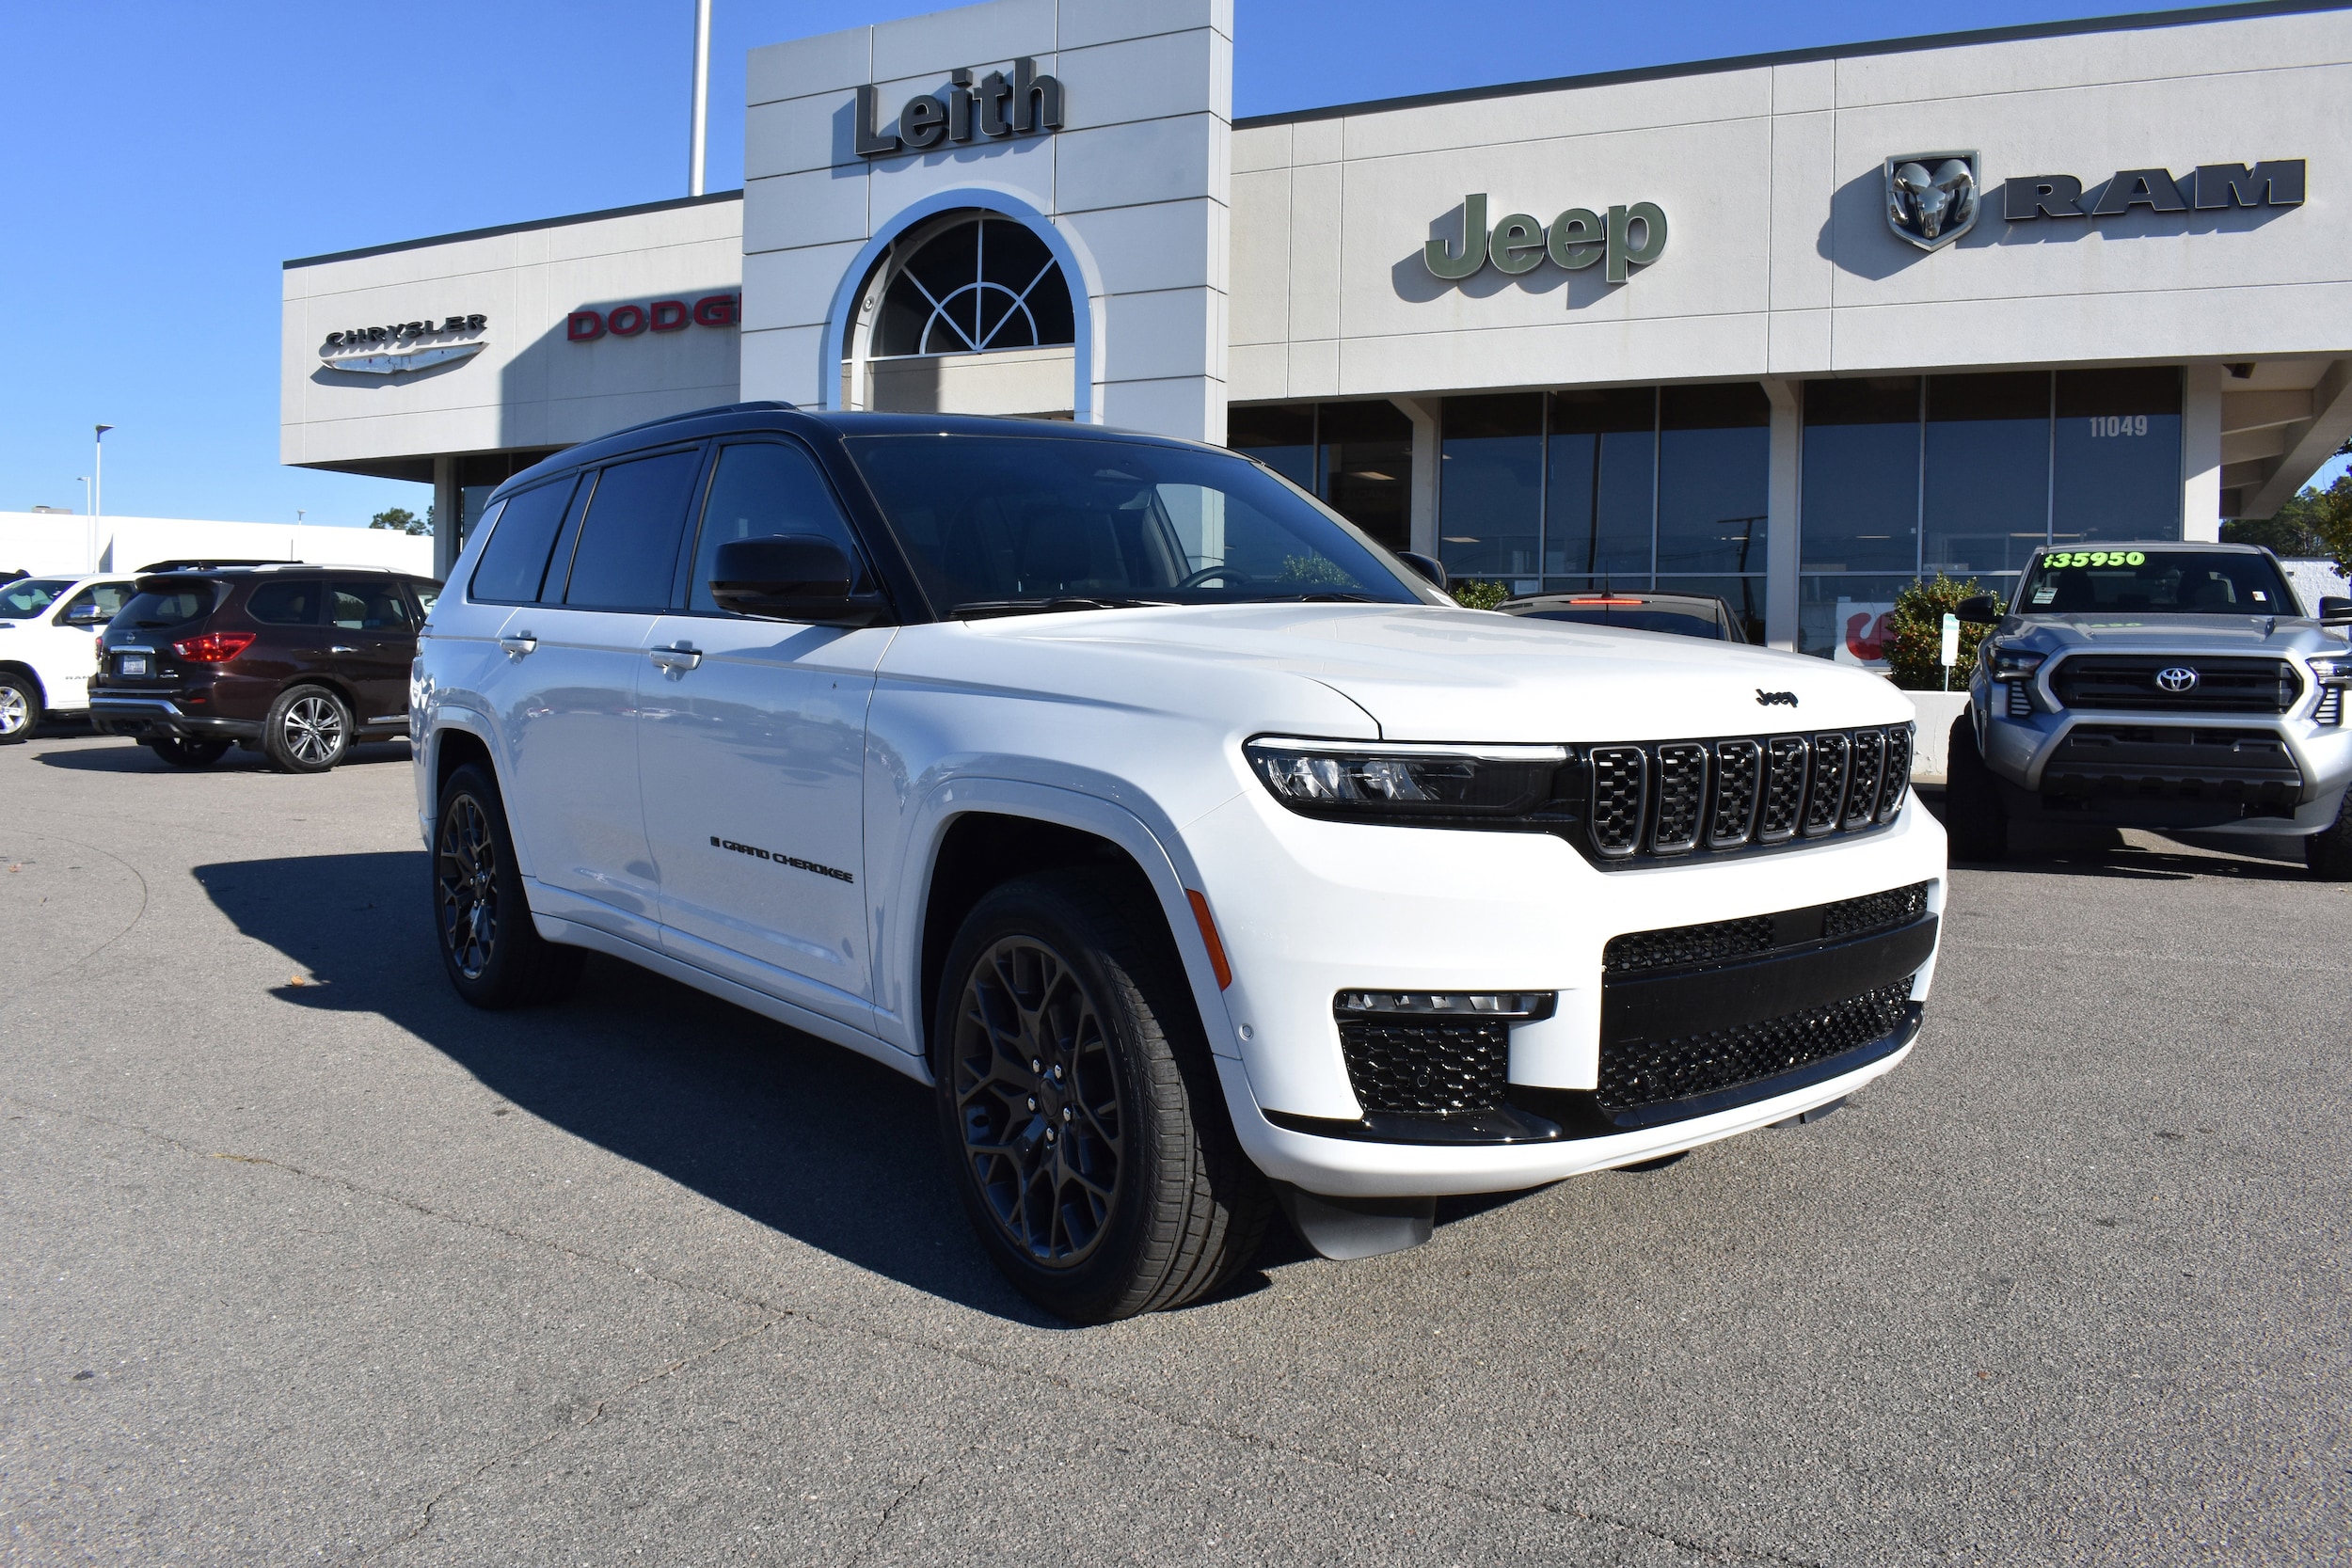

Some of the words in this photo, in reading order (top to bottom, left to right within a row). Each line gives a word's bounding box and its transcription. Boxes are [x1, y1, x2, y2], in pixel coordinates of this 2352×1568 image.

[854, 56, 1064, 156] Leith
[2004, 159, 2307, 221] RAM
[1423, 193, 1670, 284] Jeep
[325, 313, 488, 347] CHRYSLER
[567, 293, 741, 341] DODG
[2090, 415, 2148, 437] 11049
[2042, 551, 2146, 569] $35950
[1755, 689, 1799, 708] Jeep
[722, 840, 770, 860] GRAND
[772, 853, 854, 884] CHEROKEE
